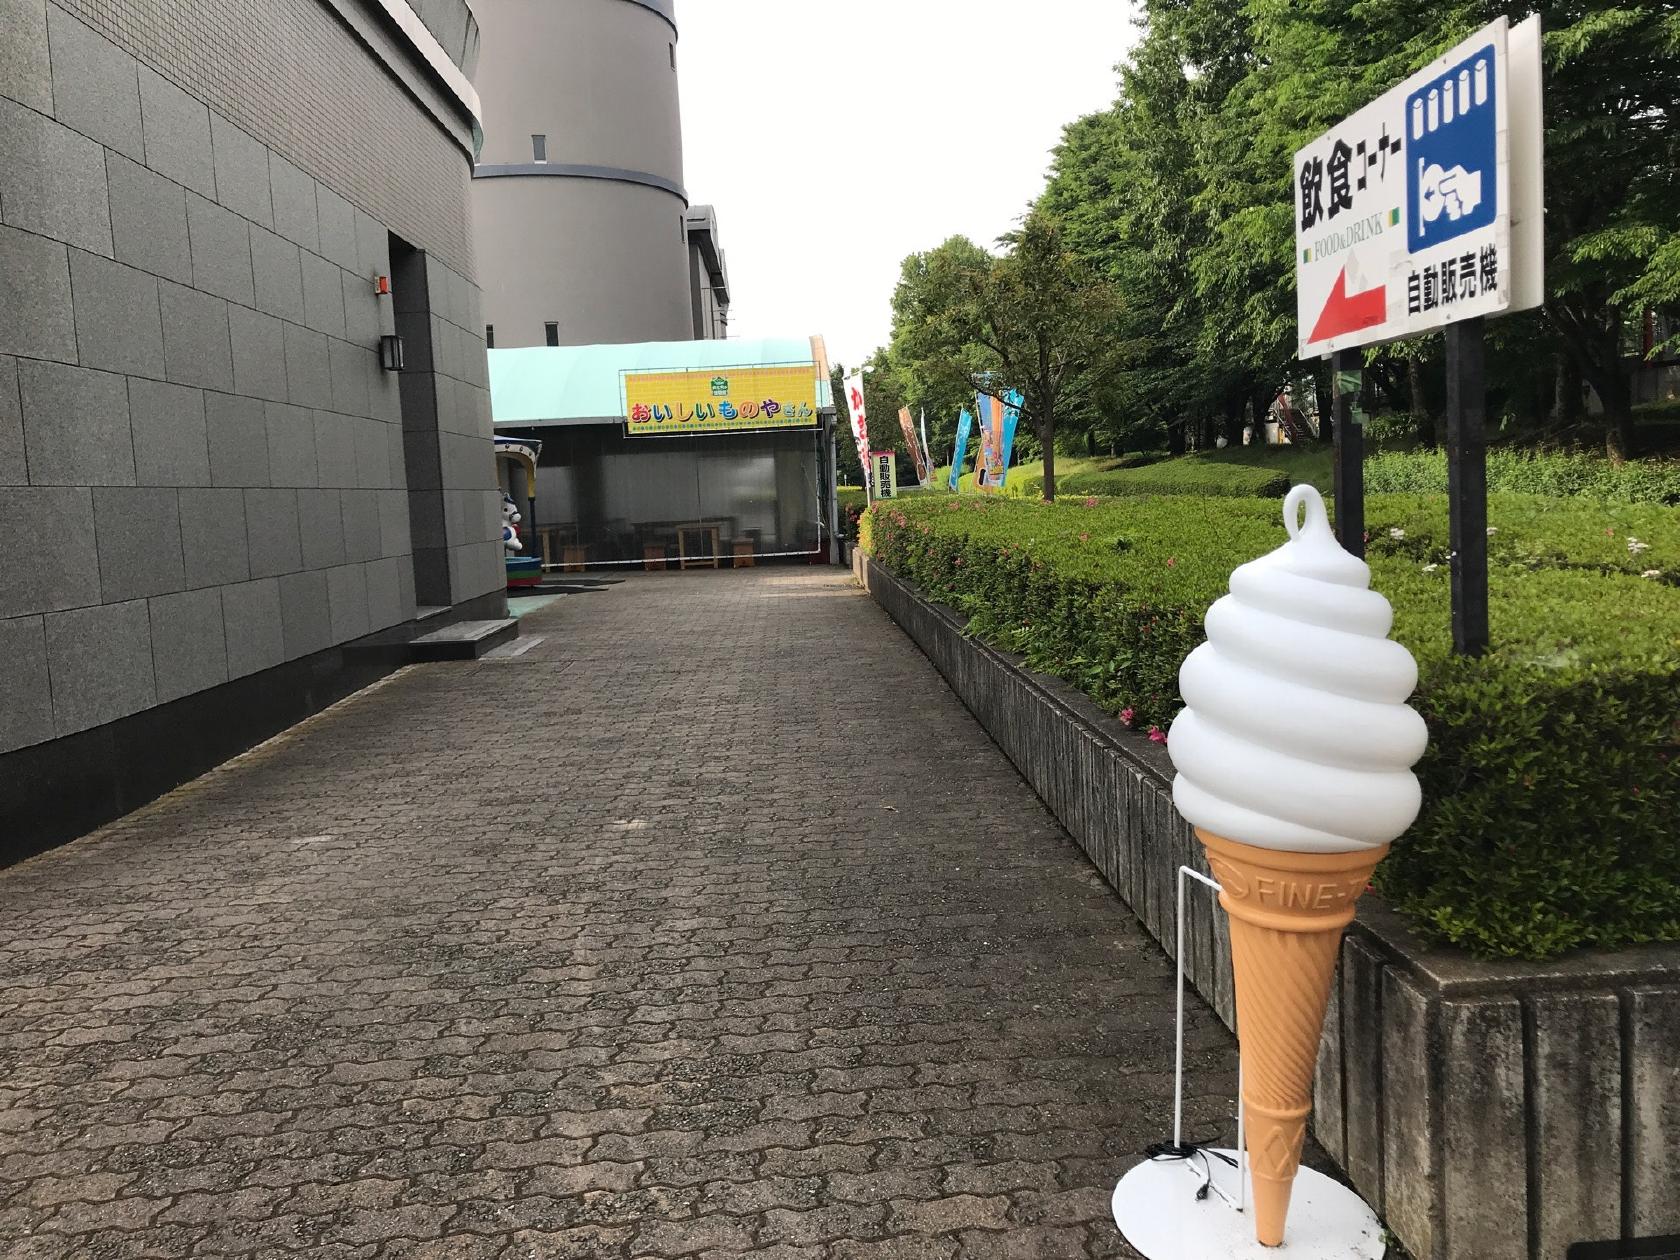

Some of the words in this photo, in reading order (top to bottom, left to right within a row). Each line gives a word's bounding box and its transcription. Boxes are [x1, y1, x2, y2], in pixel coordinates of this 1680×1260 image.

[1301, 122, 1401, 233] 飲食コーナー
[1314, 211, 1384, 262] FOOD&DRINK
[1408, 243, 1498, 316] 自動販売機
[631, 399, 814, 423] おいしいものやさん
[879, 456, 892, 497] 自動販売機
